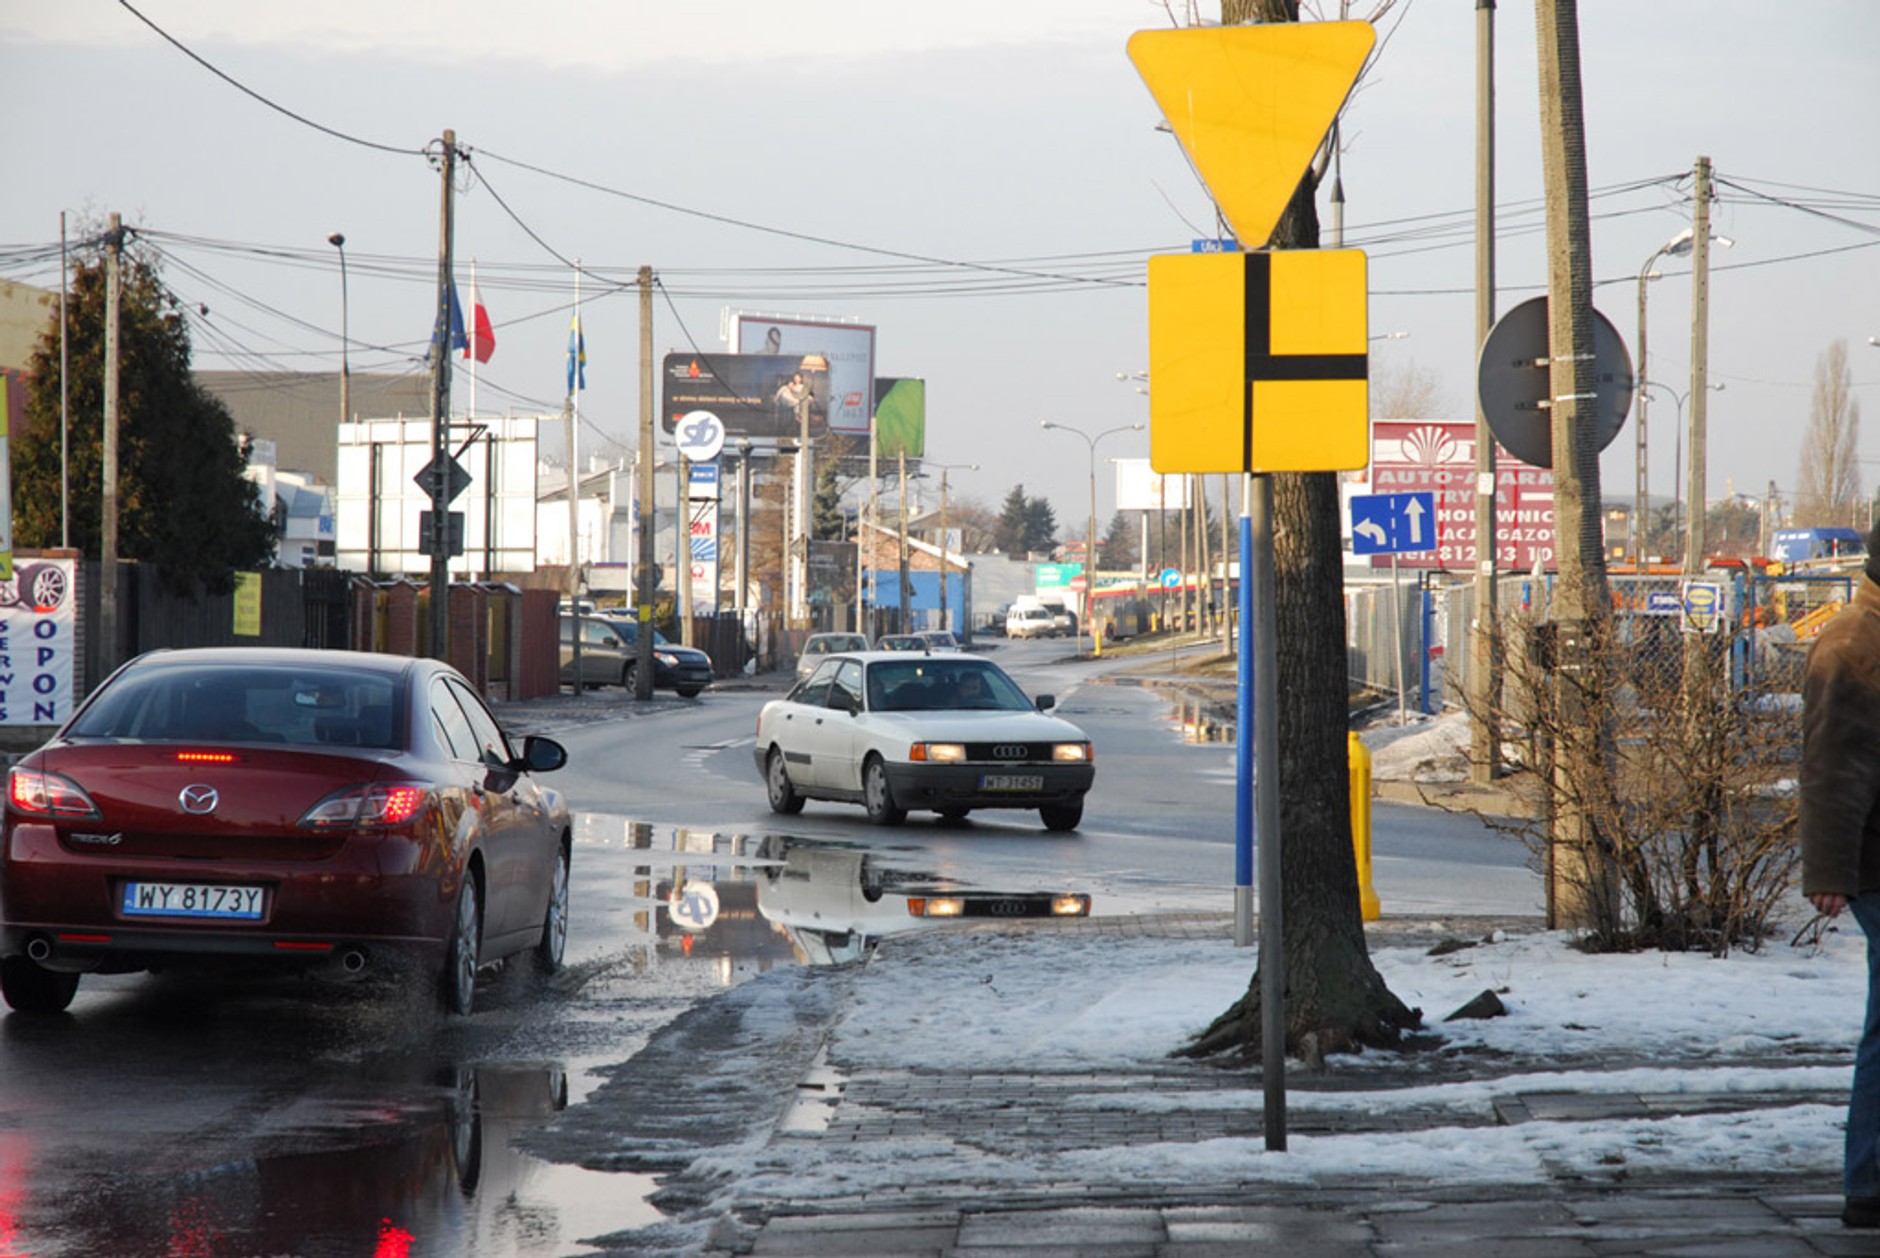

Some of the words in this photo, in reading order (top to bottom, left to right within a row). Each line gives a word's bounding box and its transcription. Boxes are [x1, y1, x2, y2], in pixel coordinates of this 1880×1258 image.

[1439, 545, 1476, 561] 812
[33, 619, 57, 721] OPON
[139, 885, 174, 910] WY
[182, 886, 259, 912] 8173Y
